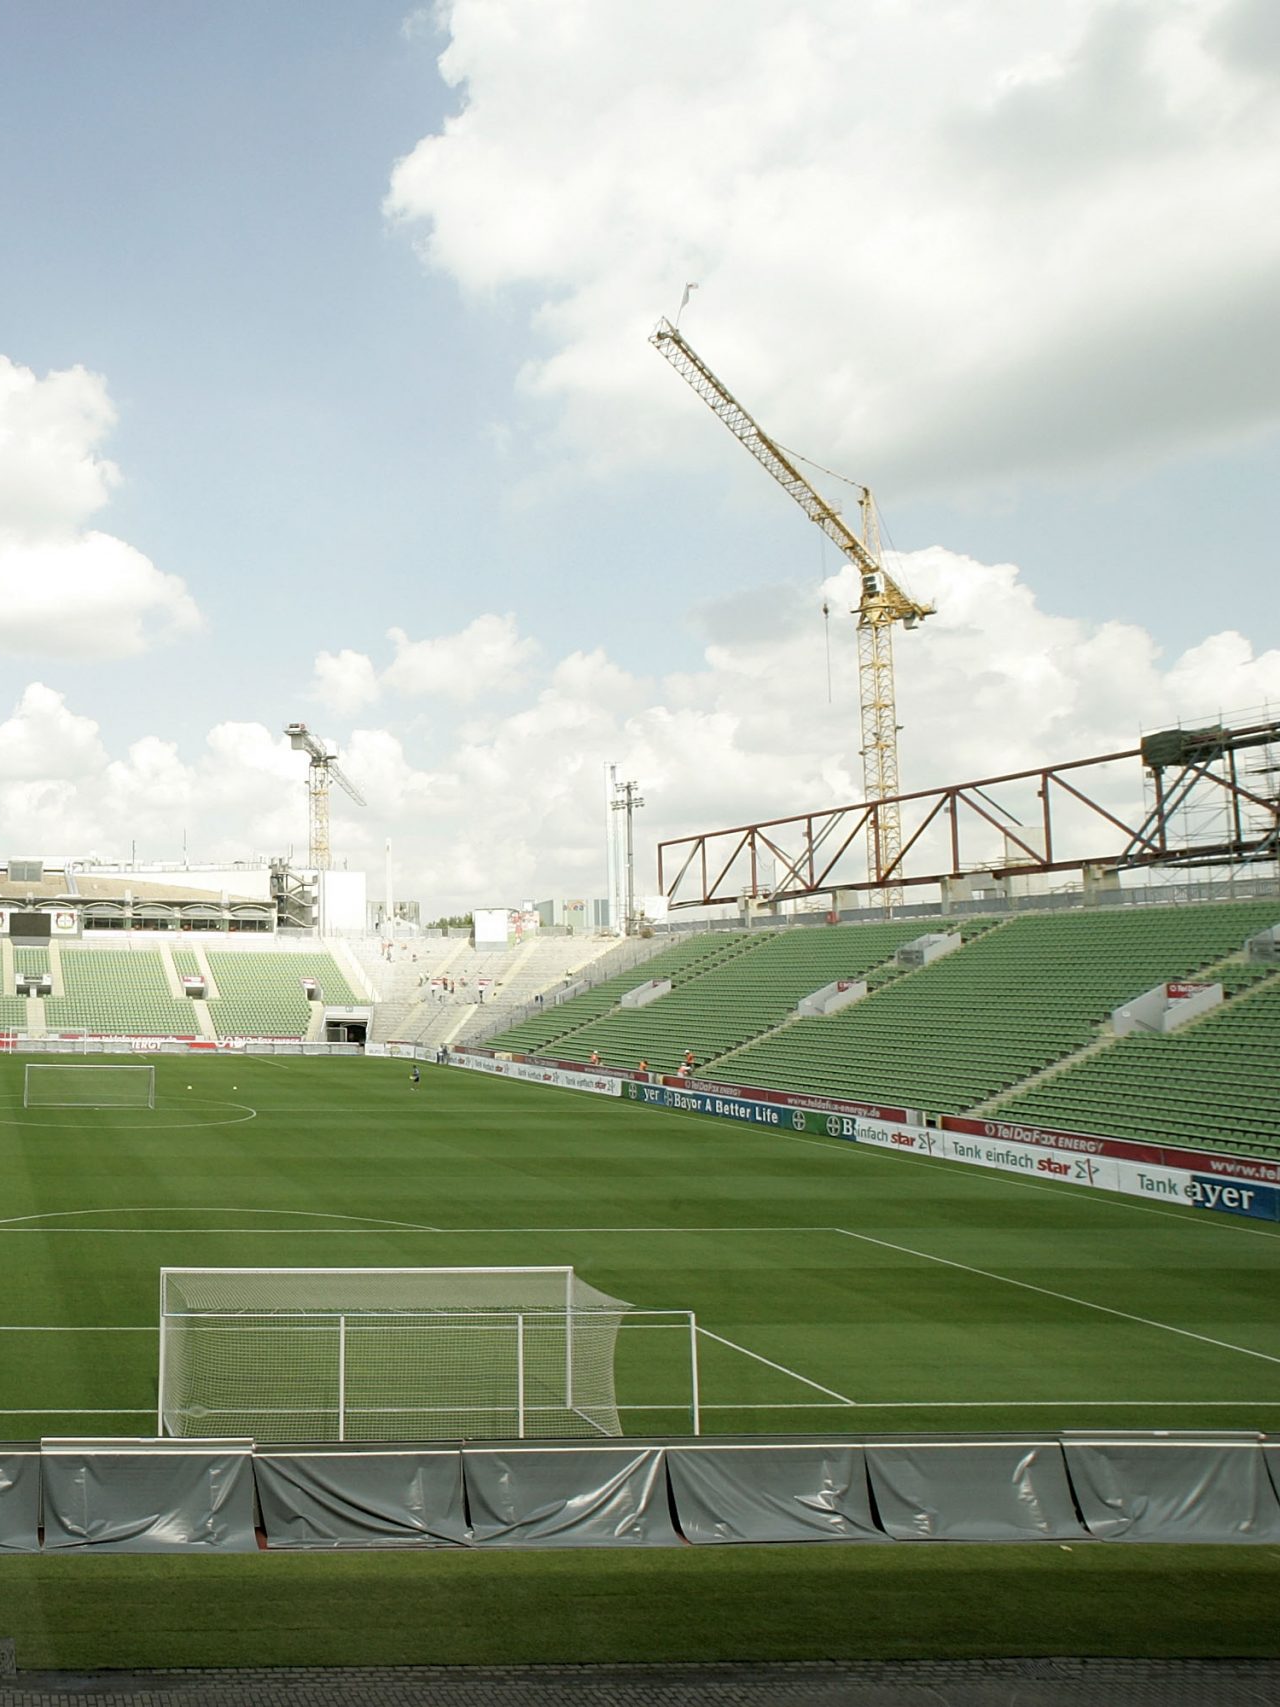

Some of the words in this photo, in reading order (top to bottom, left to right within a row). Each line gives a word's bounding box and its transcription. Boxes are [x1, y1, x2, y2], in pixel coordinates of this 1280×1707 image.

[705, 1099, 712, 1112] A
[715, 1100, 751, 1119] Better
[755, 1107, 779, 1123] Life
[890, 1131, 916, 1147] star
[996, 1124, 1057, 1146] TelDaFax
[1058, 1136, 1104, 1153] ENERGY
[952, 1141, 982, 1160] Tank
[985, 1147, 1034, 1169] einfach
[1036, 1157, 1072, 1176] star
[1137, 1173, 1179, 1196] Tank
